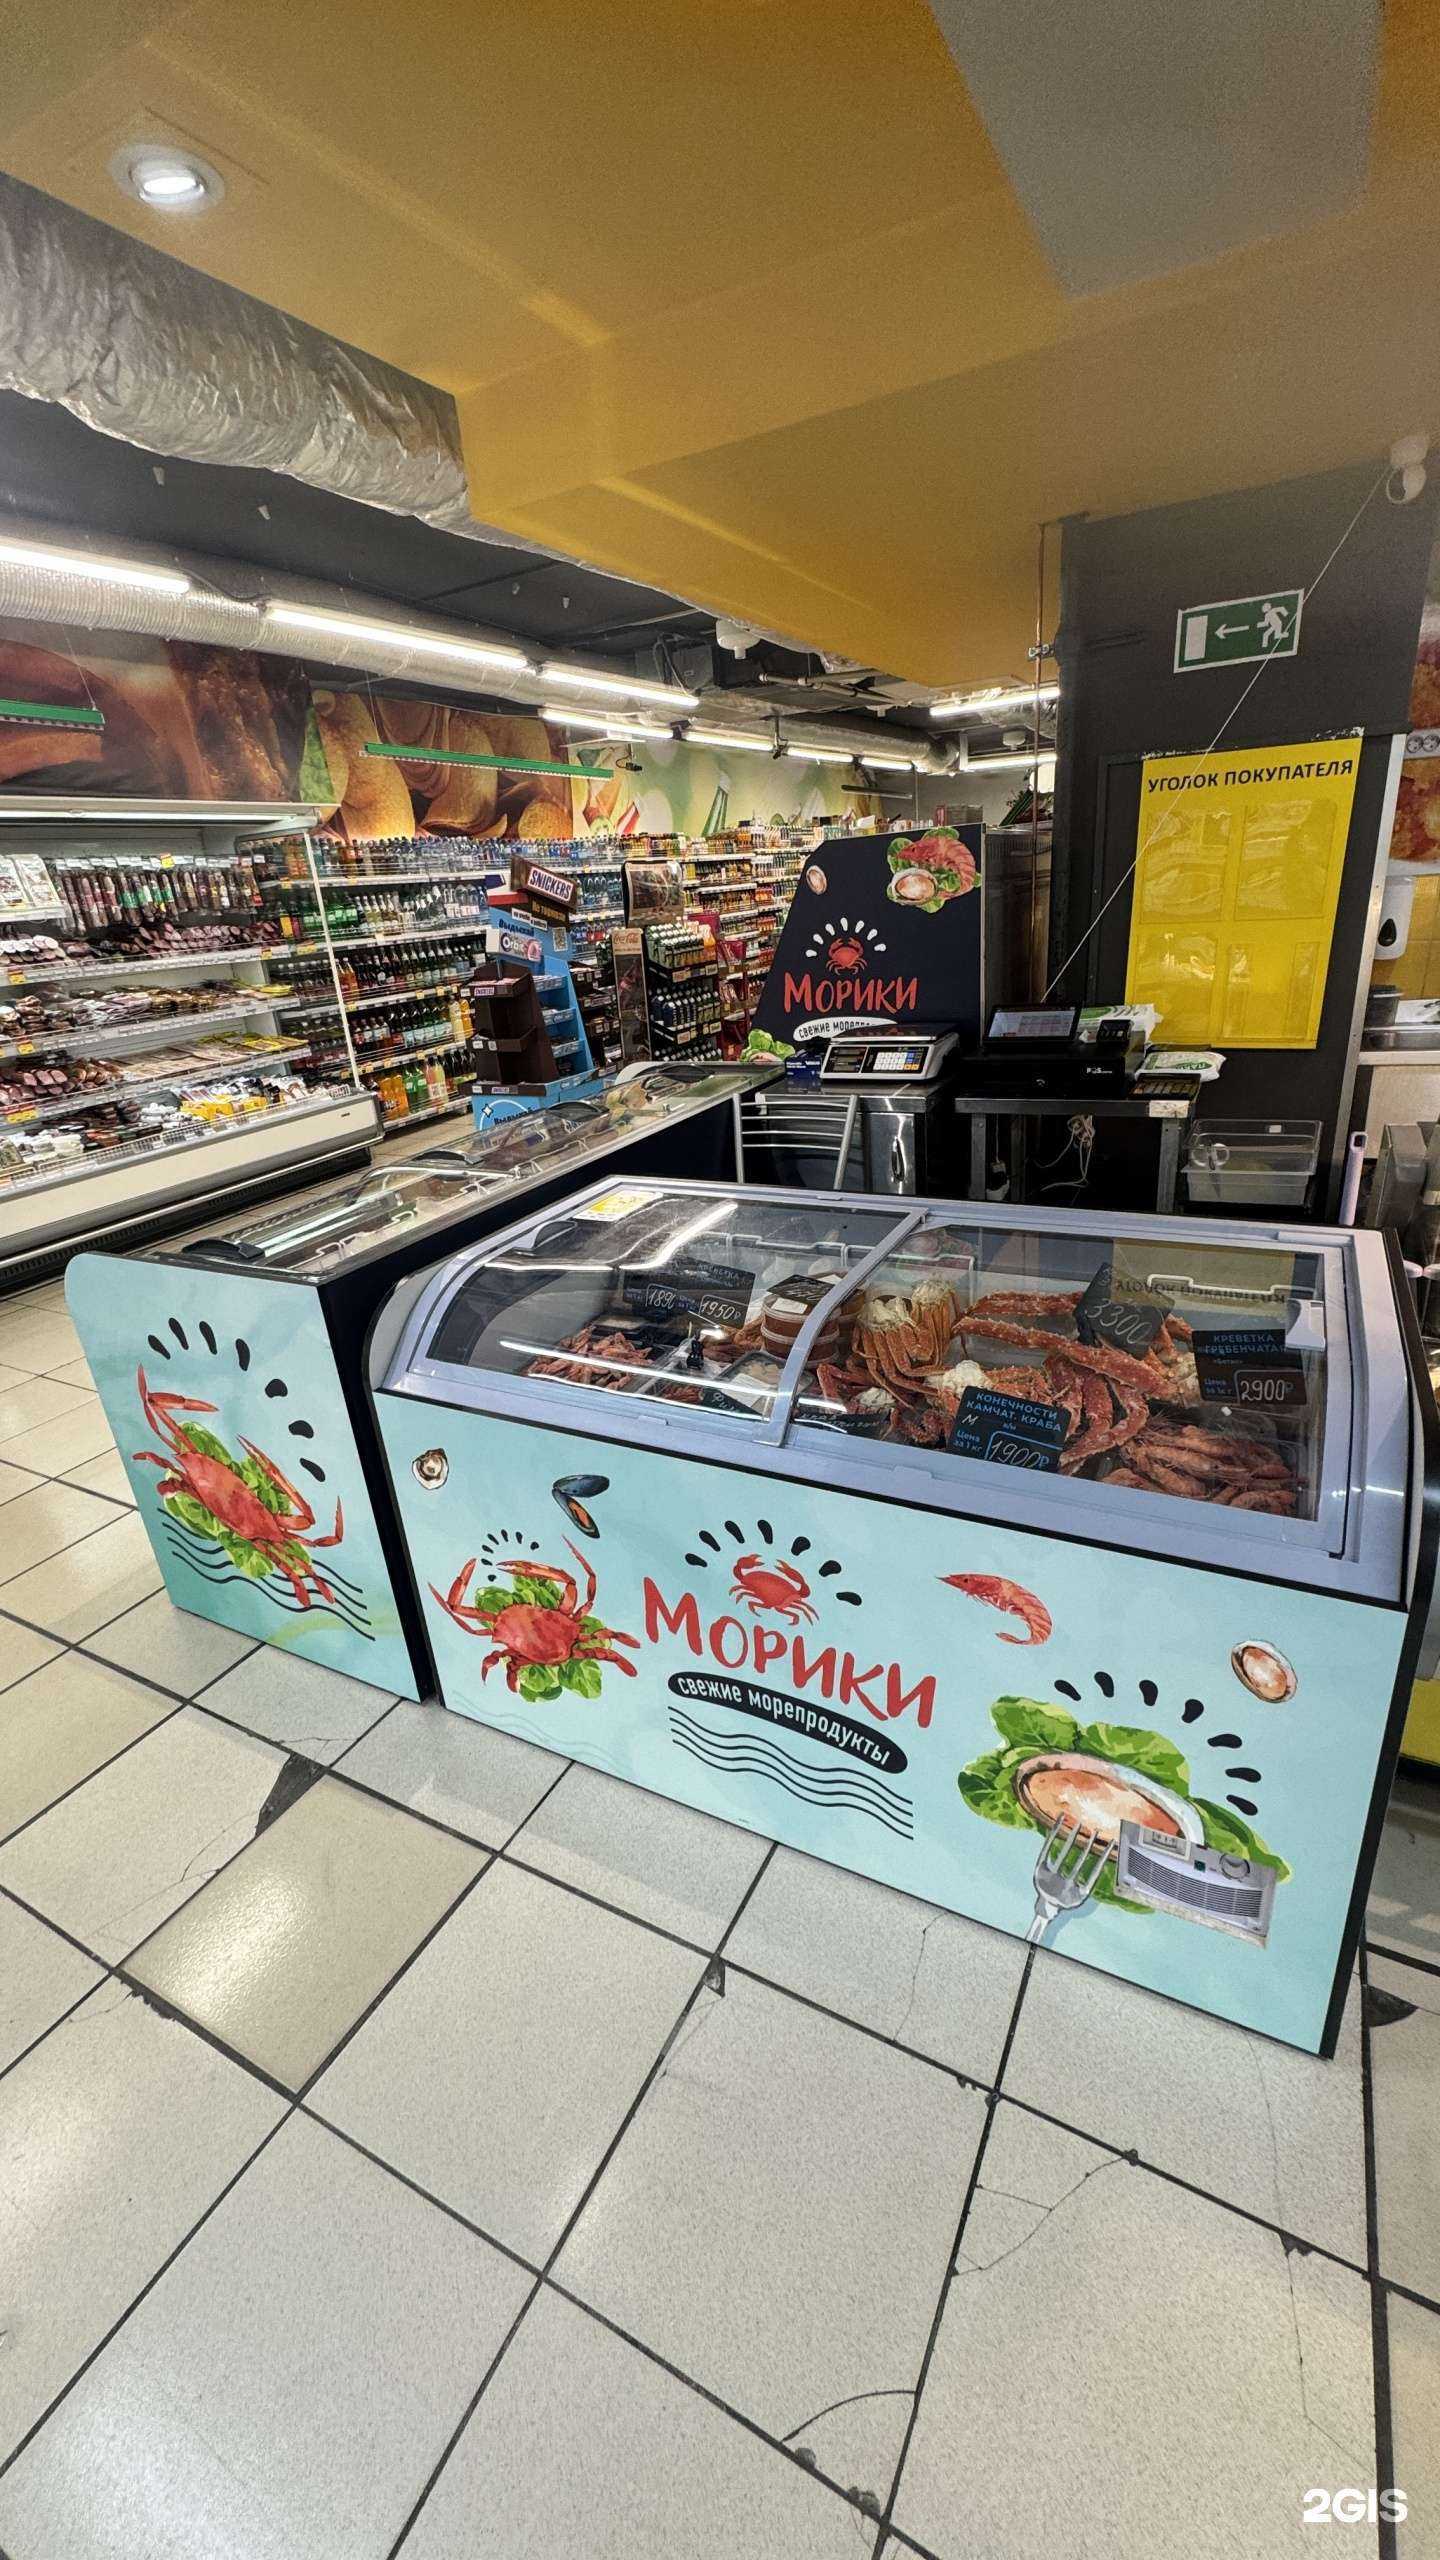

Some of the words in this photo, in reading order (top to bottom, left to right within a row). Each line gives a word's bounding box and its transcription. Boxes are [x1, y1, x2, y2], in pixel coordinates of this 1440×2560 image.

[1148, 774, 1219, 793] УГОЛОК
[1224, 760, 1353, 786] ПОКУПАТЕЛЯ
[529, 869, 572, 900] SNICKERS
[799, 1021, 831, 1039] свежие
[1213, 1333, 1275, 1344] КРЕВЕТКА
[976, 1393, 1058, 1420] КОНЕЧНОСТИ
[1021, 1414, 1062, 1432] КРАБА
[677, 1677, 743, 1704] свежие
[749, 1689, 891, 1766] морепродукты
